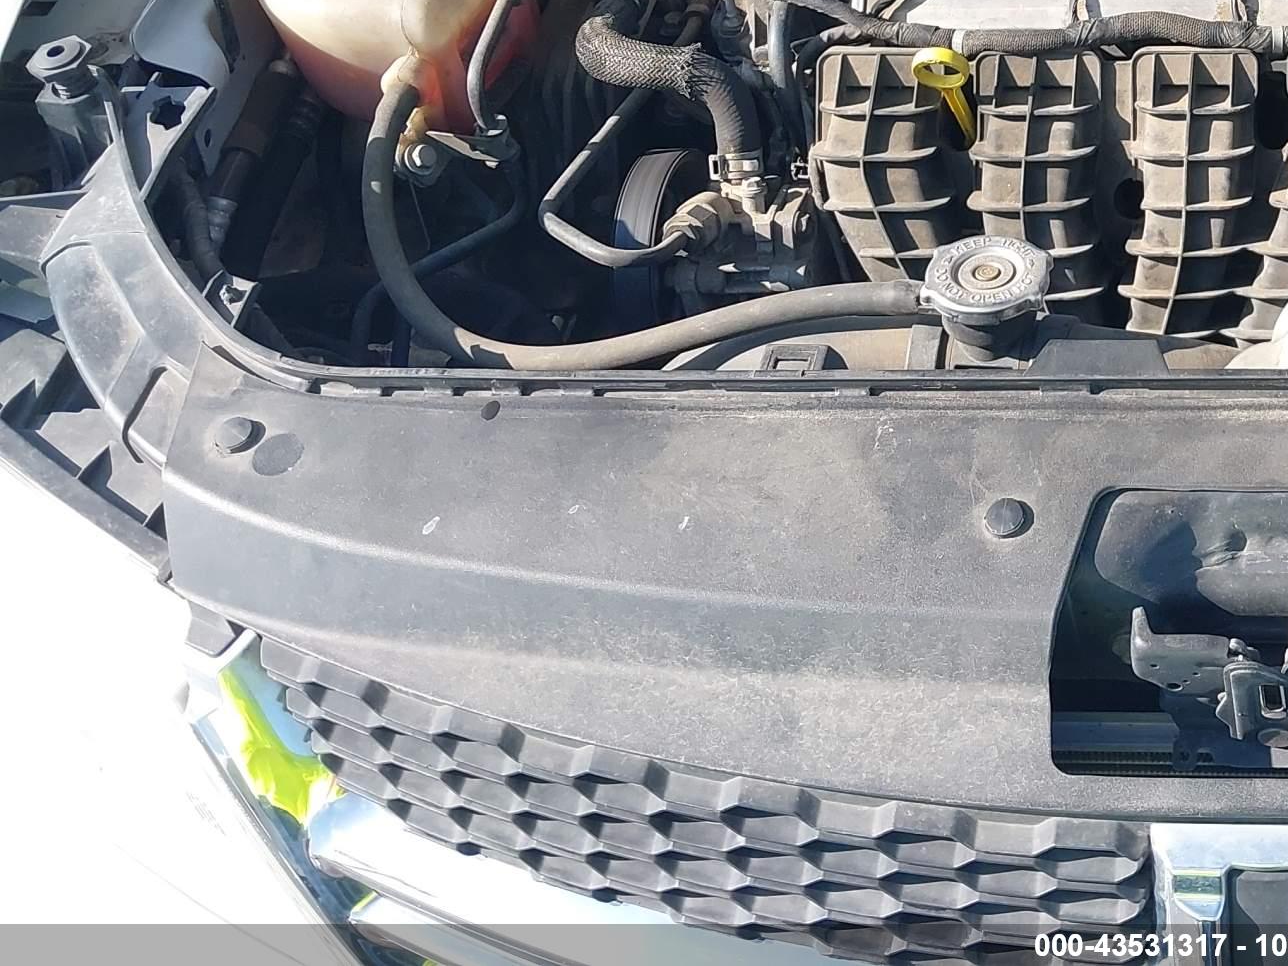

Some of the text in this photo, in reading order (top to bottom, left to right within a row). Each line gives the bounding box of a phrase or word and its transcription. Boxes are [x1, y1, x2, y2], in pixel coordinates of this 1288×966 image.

[951, 237, 991, 255] KEEP
[943, 282, 966, 299] NOT
[970, 289, 1014, 303] OPEN
